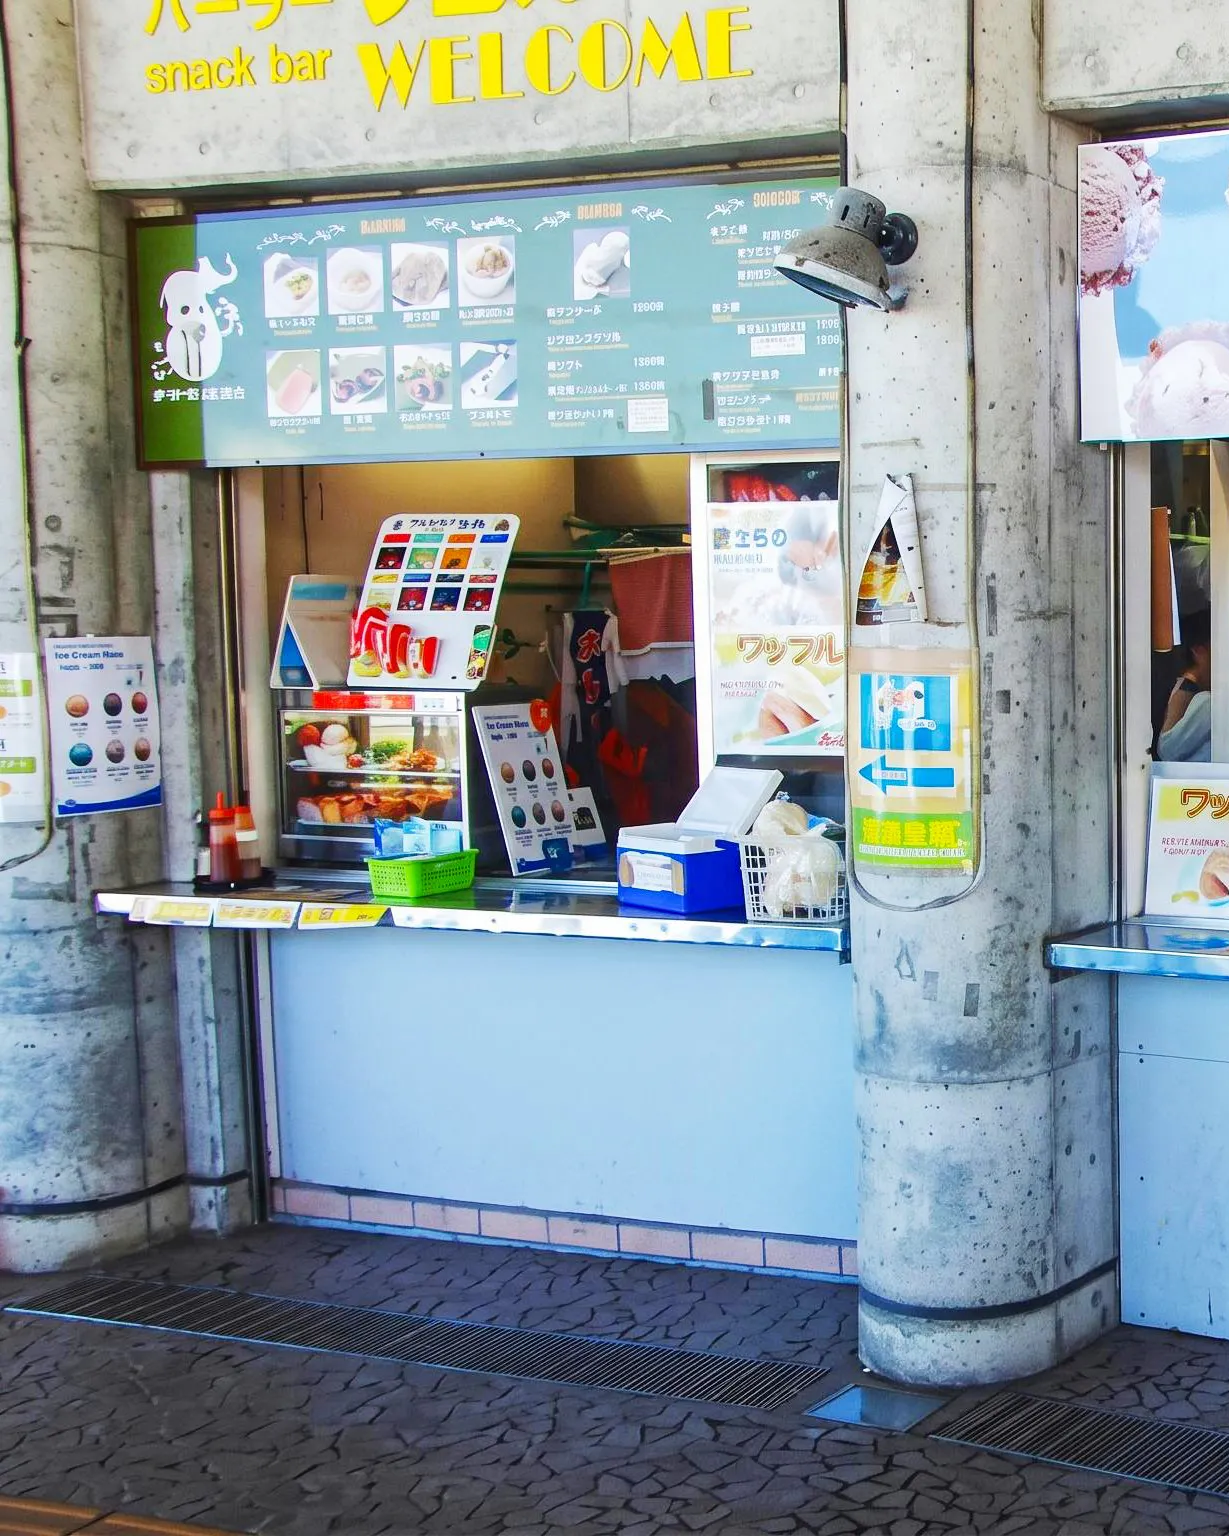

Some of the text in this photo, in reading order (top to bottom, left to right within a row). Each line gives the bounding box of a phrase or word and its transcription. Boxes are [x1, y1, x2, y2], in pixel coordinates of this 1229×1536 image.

[145, 43, 332, 94] snack bar
[356, 6, 753, 111] WELCOME
[737, 633, 844, 667] ワッフル
